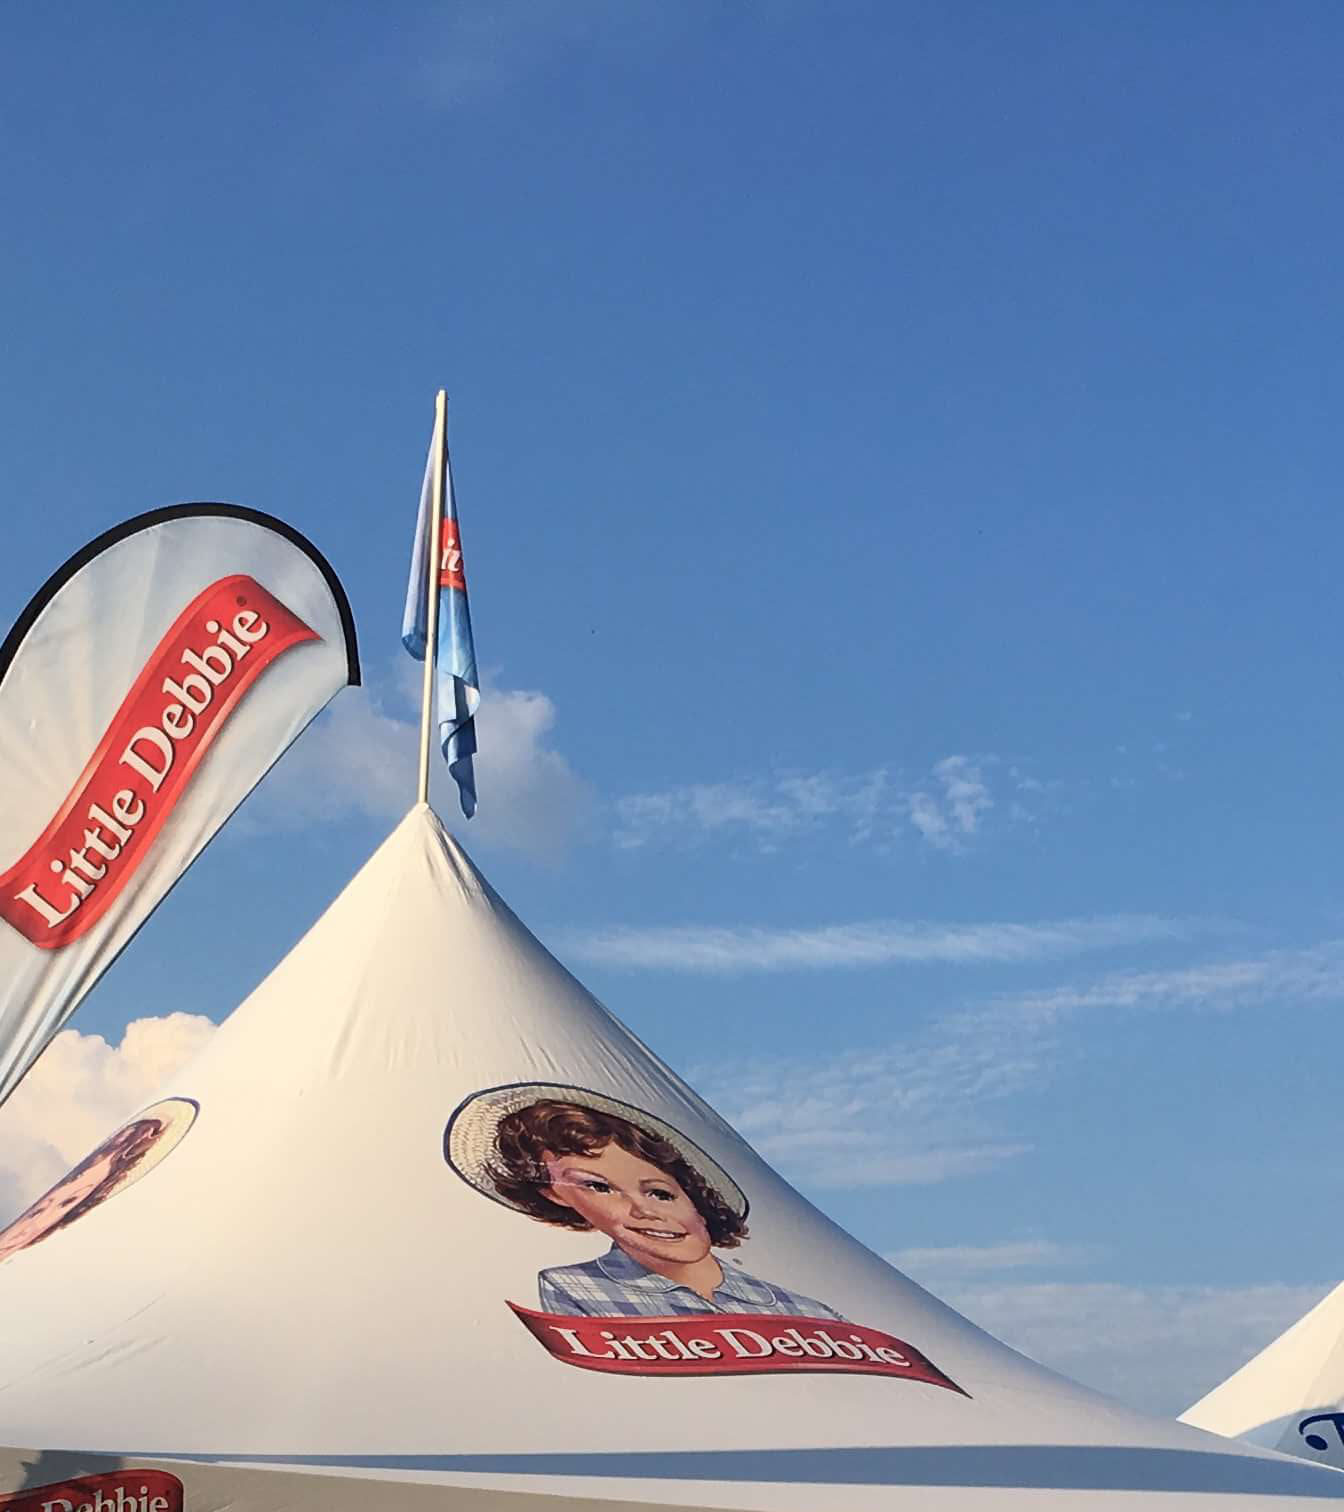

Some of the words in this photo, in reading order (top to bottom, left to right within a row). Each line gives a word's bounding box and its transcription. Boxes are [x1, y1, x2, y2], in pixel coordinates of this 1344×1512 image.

[14, 789, 146, 930] Little
[119, 604, 271, 793] Debbie
[550, 1325, 722, 1361] Little
[713, 1327, 913, 1369] Debbie
